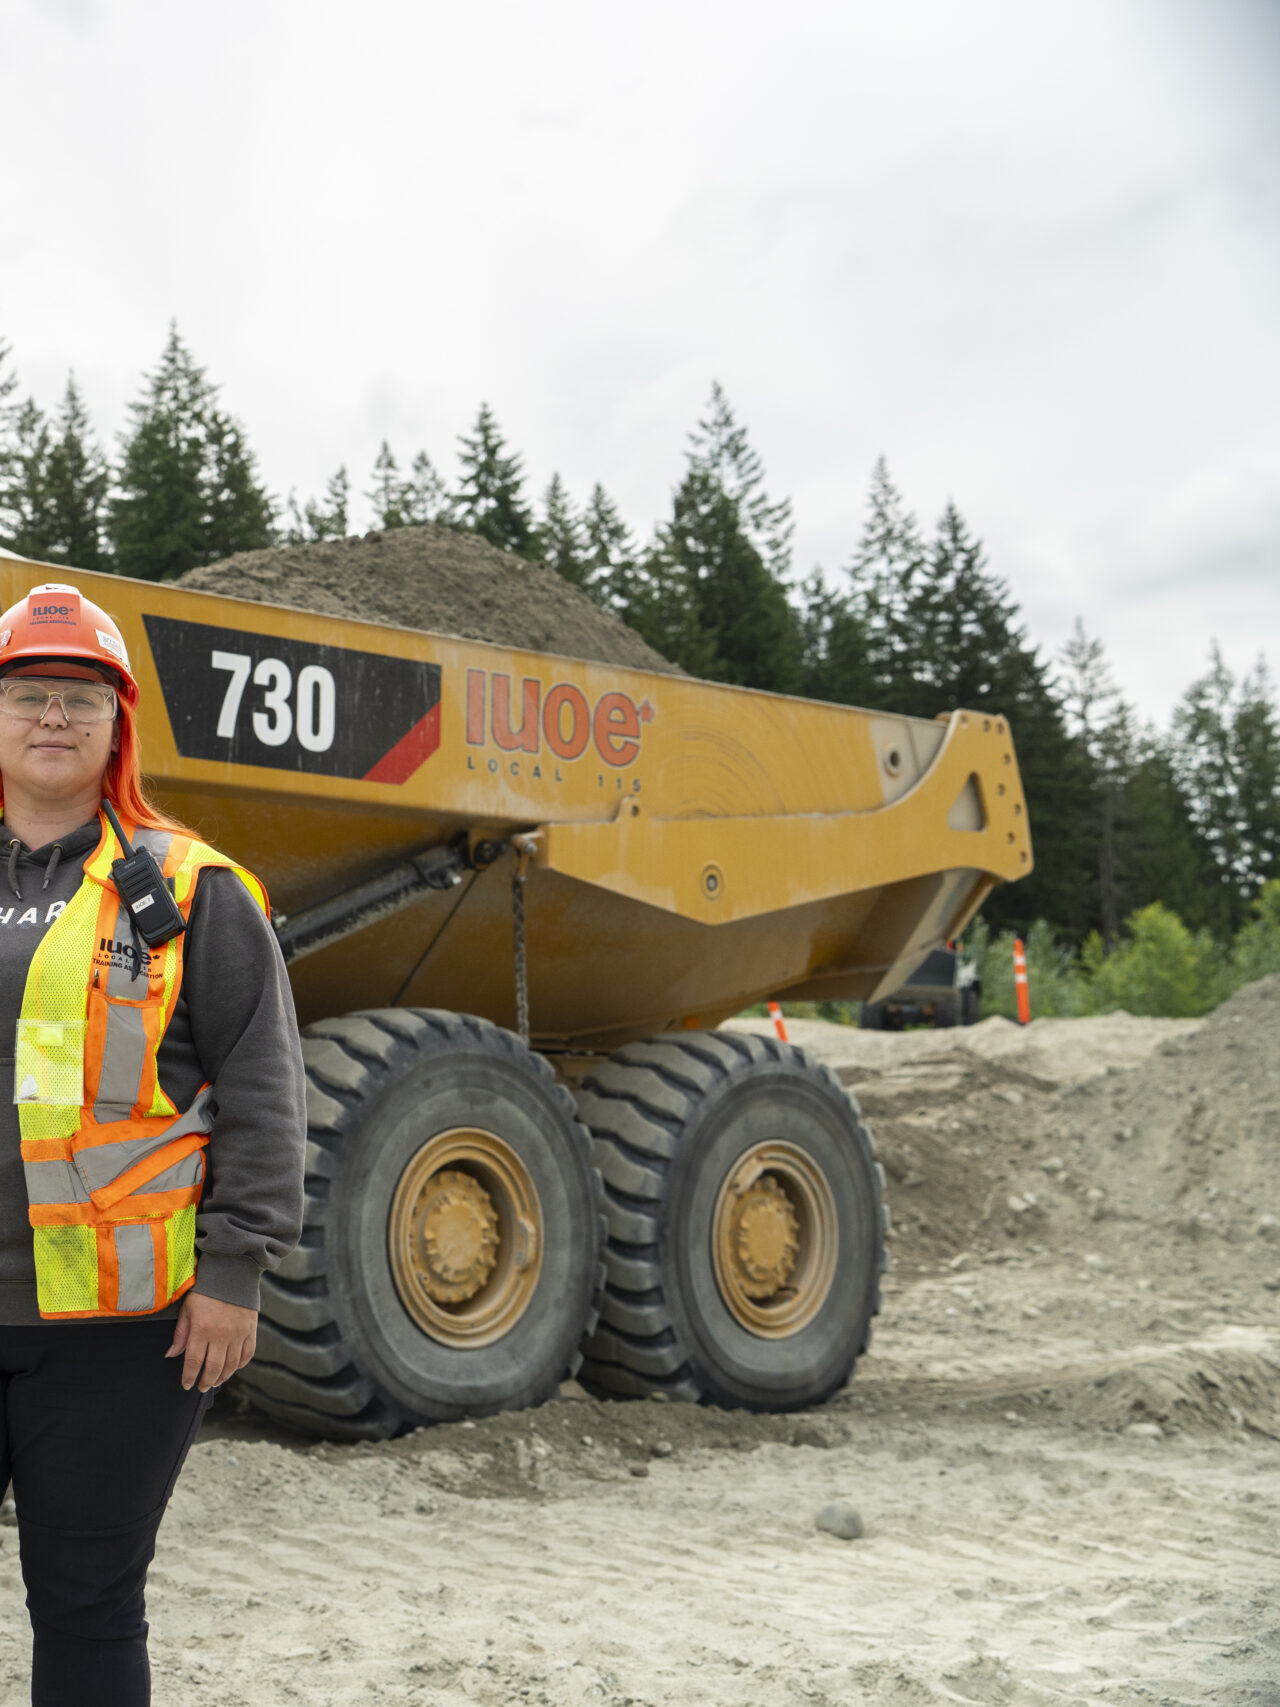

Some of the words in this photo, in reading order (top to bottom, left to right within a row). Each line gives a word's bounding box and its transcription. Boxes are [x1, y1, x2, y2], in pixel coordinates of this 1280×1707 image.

[210, 650, 336, 752] 730
[467, 756, 563, 782] LOCAL
[598, 775, 641, 792] 115
[93, 958, 123, 969] TRAINING
[123, 965, 164, 979] ASCIATION
